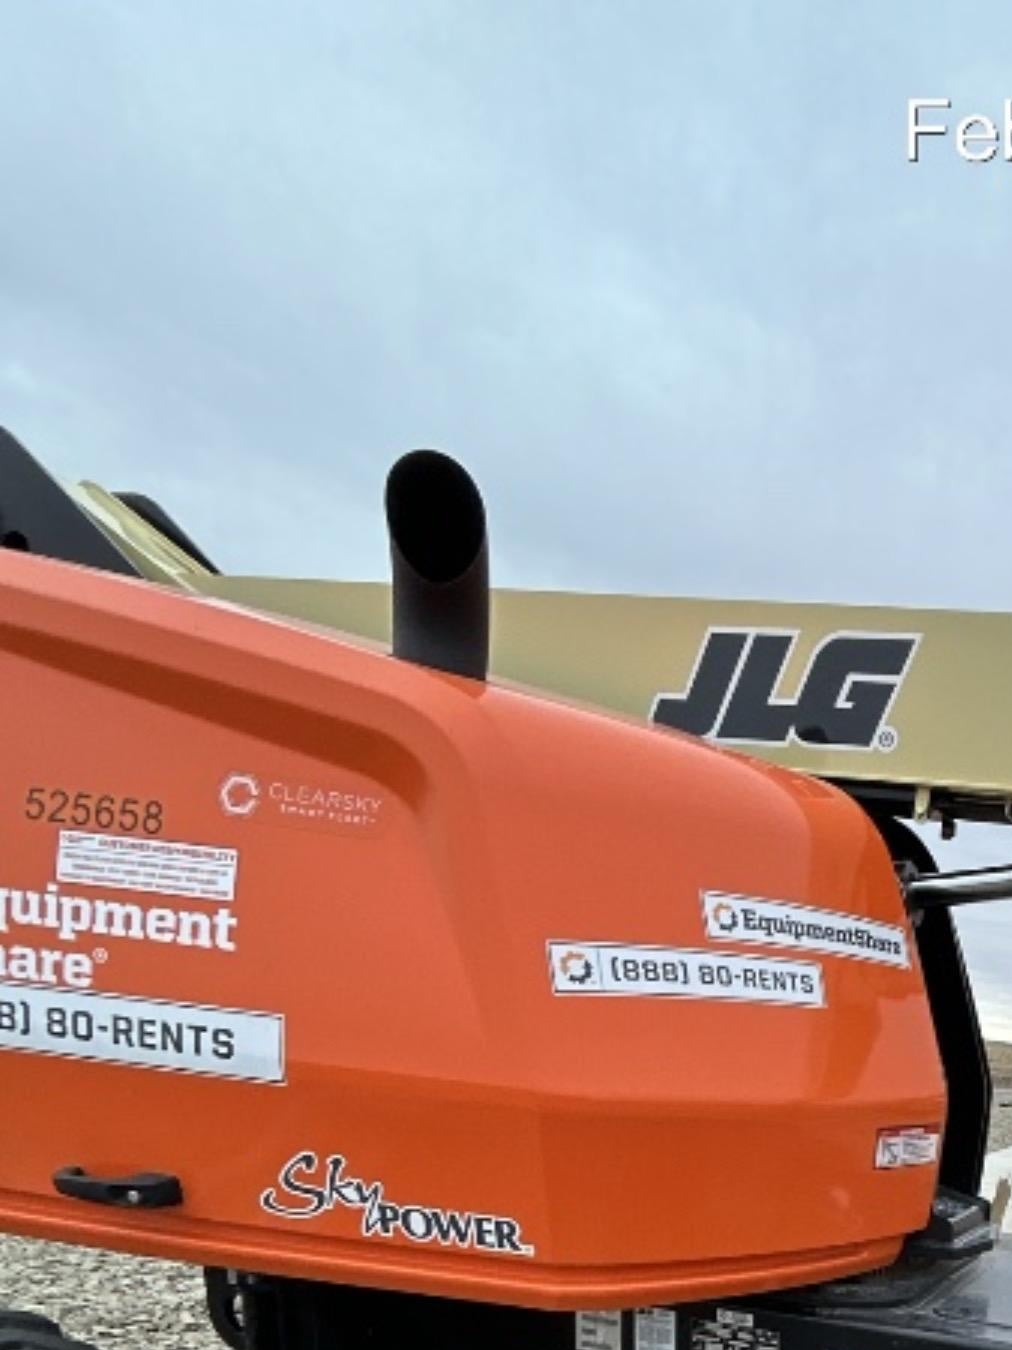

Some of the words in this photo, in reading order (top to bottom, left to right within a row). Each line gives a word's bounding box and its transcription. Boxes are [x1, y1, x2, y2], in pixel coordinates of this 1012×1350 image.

[649, 626, 923, 751] JLG
[25, 787, 164, 835] 525658
[610, 956, 690, 985] (888)
[698, 964, 815, 995] 80-RENTS
[46, 1007, 236, 1060] 80-RENTS
